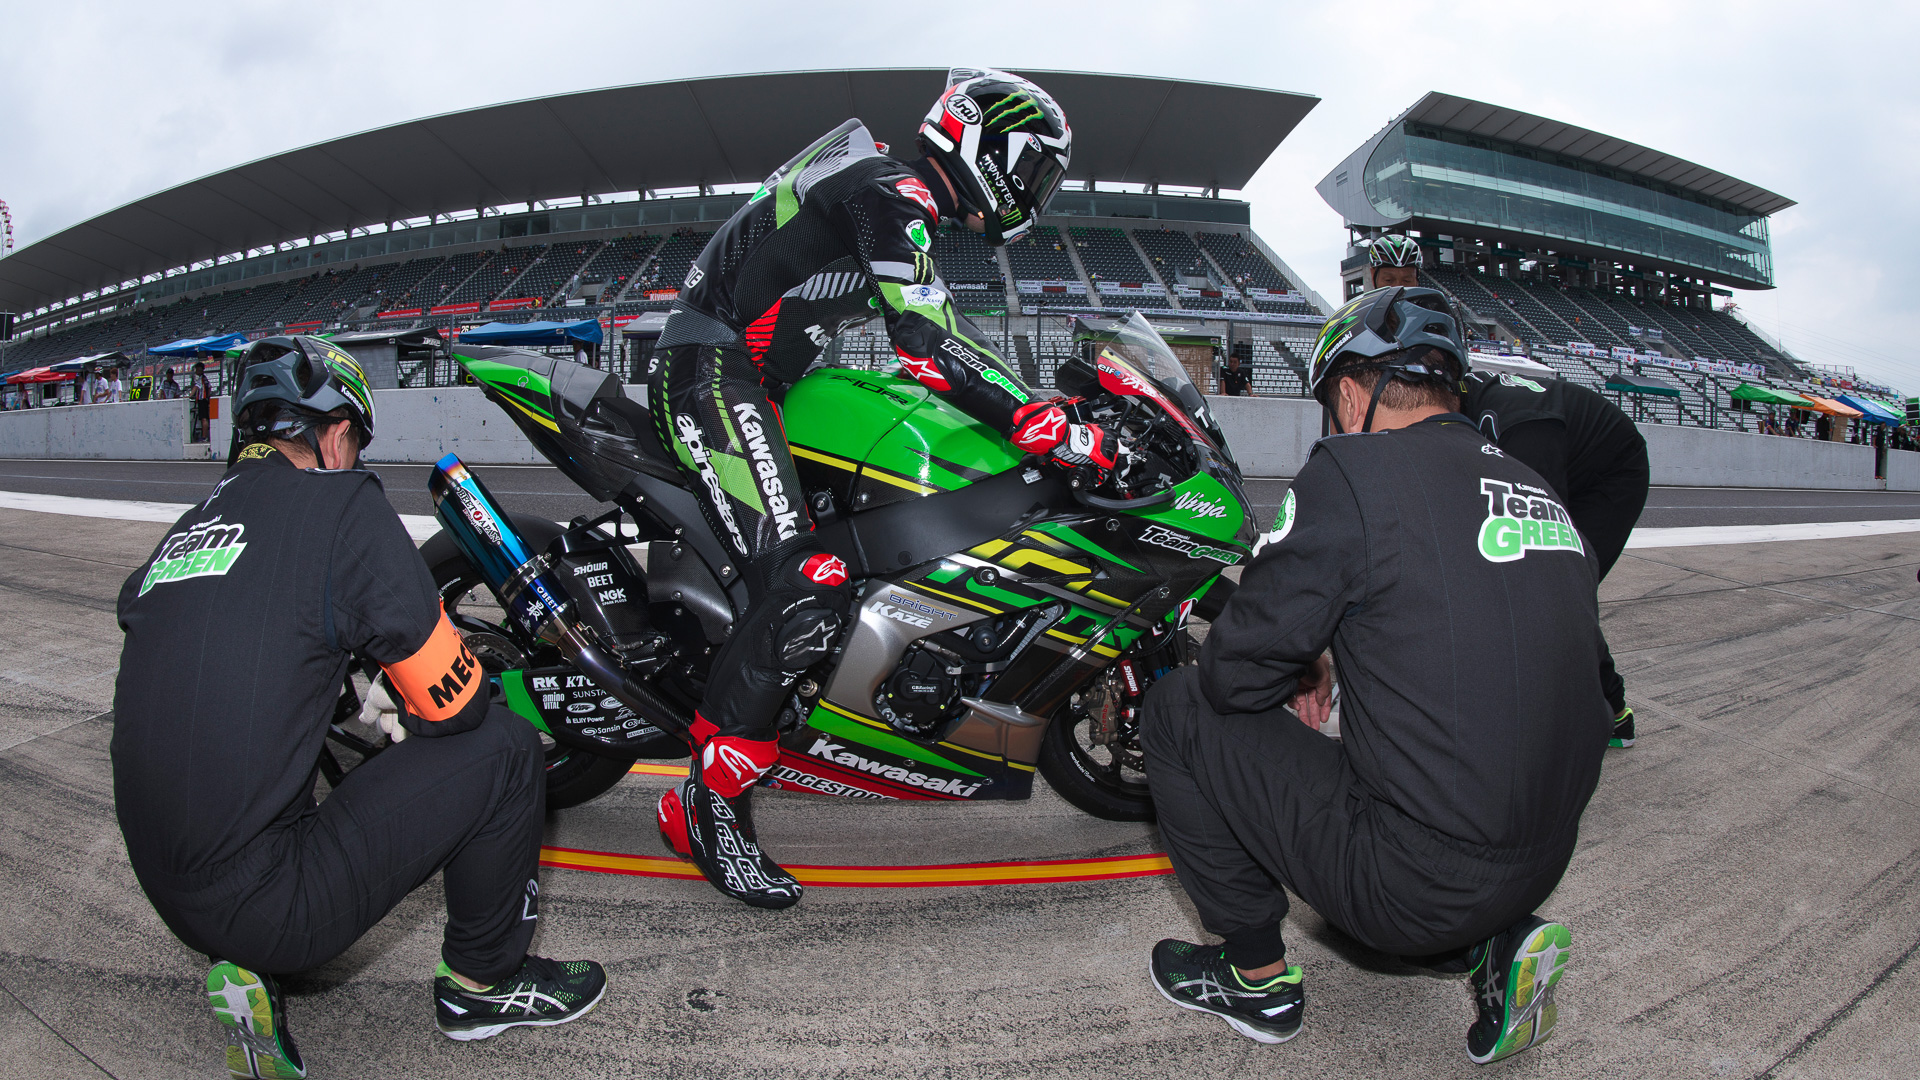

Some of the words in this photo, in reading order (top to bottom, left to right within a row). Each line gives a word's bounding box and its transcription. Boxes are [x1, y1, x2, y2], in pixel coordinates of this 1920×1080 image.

[948, 96, 981, 122] Arai
[981, 153, 1017, 209] MONSTER
[949, 282, 988, 290] Kawasaki
[1324, 331, 1354, 362] Kawasaki
[940, 338, 987, 373] Team
[981, 368, 1030, 405] GREEN
[1097, 363, 1116, 375] elf
[131, 388, 141, 400] 76
[341, 385, 366, 415] Kawasaki
[733, 402, 800, 541] Kawasaki
[456, 488, 478, 512] BEET
[1174, 491, 1228, 520] Ninja
[1482, 480, 1574, 526] Team
[156, 525, 243, 563] Team
[1138, 524, 1199, 555] Team
[1187, 546, 1244, 566] GREEN
[1480, 517, 1585, 560] GREEN
[138, 546, 246, 598] GREEN
[587, 573, 614, 588] BEET
[541, 592, 558, 609] BEET
[600, 588, 625, 602] NGK
[869, 601, 934, 629] KAZE
[532, 676, 560, 689] RK
[1123, 665, 1138, 692] SHOWA
[543, 691, 565, 702] amino
[543, 701, 561, 710] VITAL
[597, 724, 621, 734] Sansin
[807, 738, 982, 798] Kawasaki
[736, 857, 773, 890] 65
